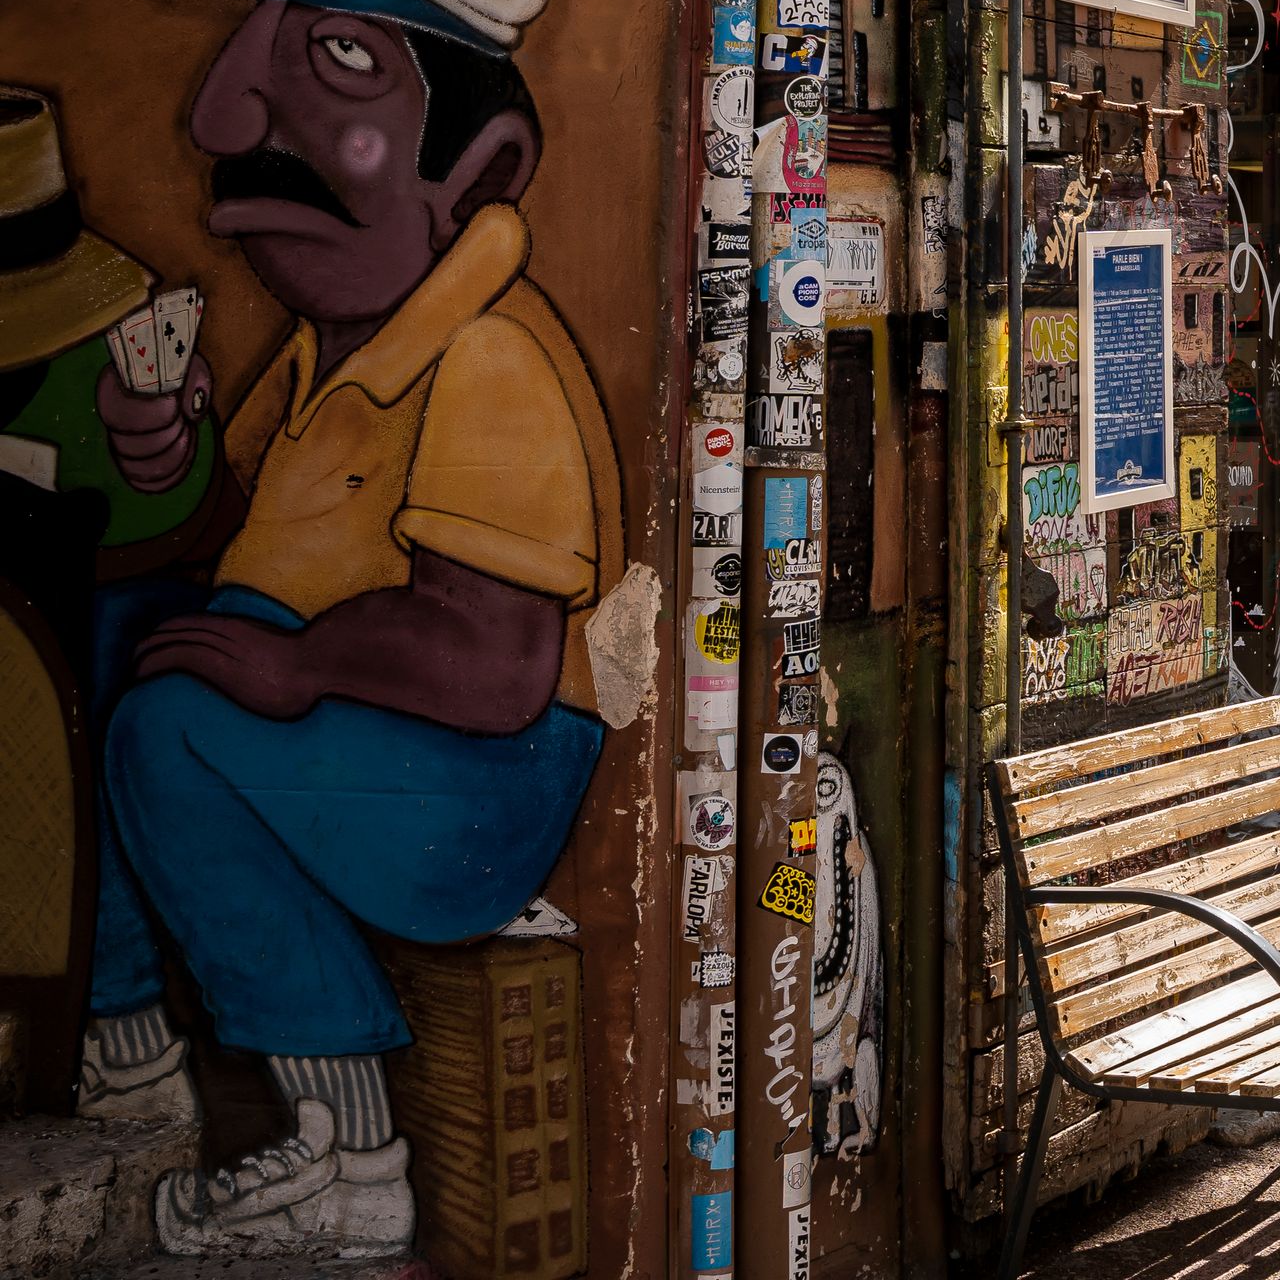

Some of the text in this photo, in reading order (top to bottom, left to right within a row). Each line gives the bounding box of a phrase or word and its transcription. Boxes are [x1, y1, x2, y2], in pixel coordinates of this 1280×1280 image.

[800, 84, 812, 92] THE
[1112, 254, 1128, 264] PARLE
[1128, 253, 1140, 263] BIEN
[717, 1007, 735, 1111] J'EXISTE.
